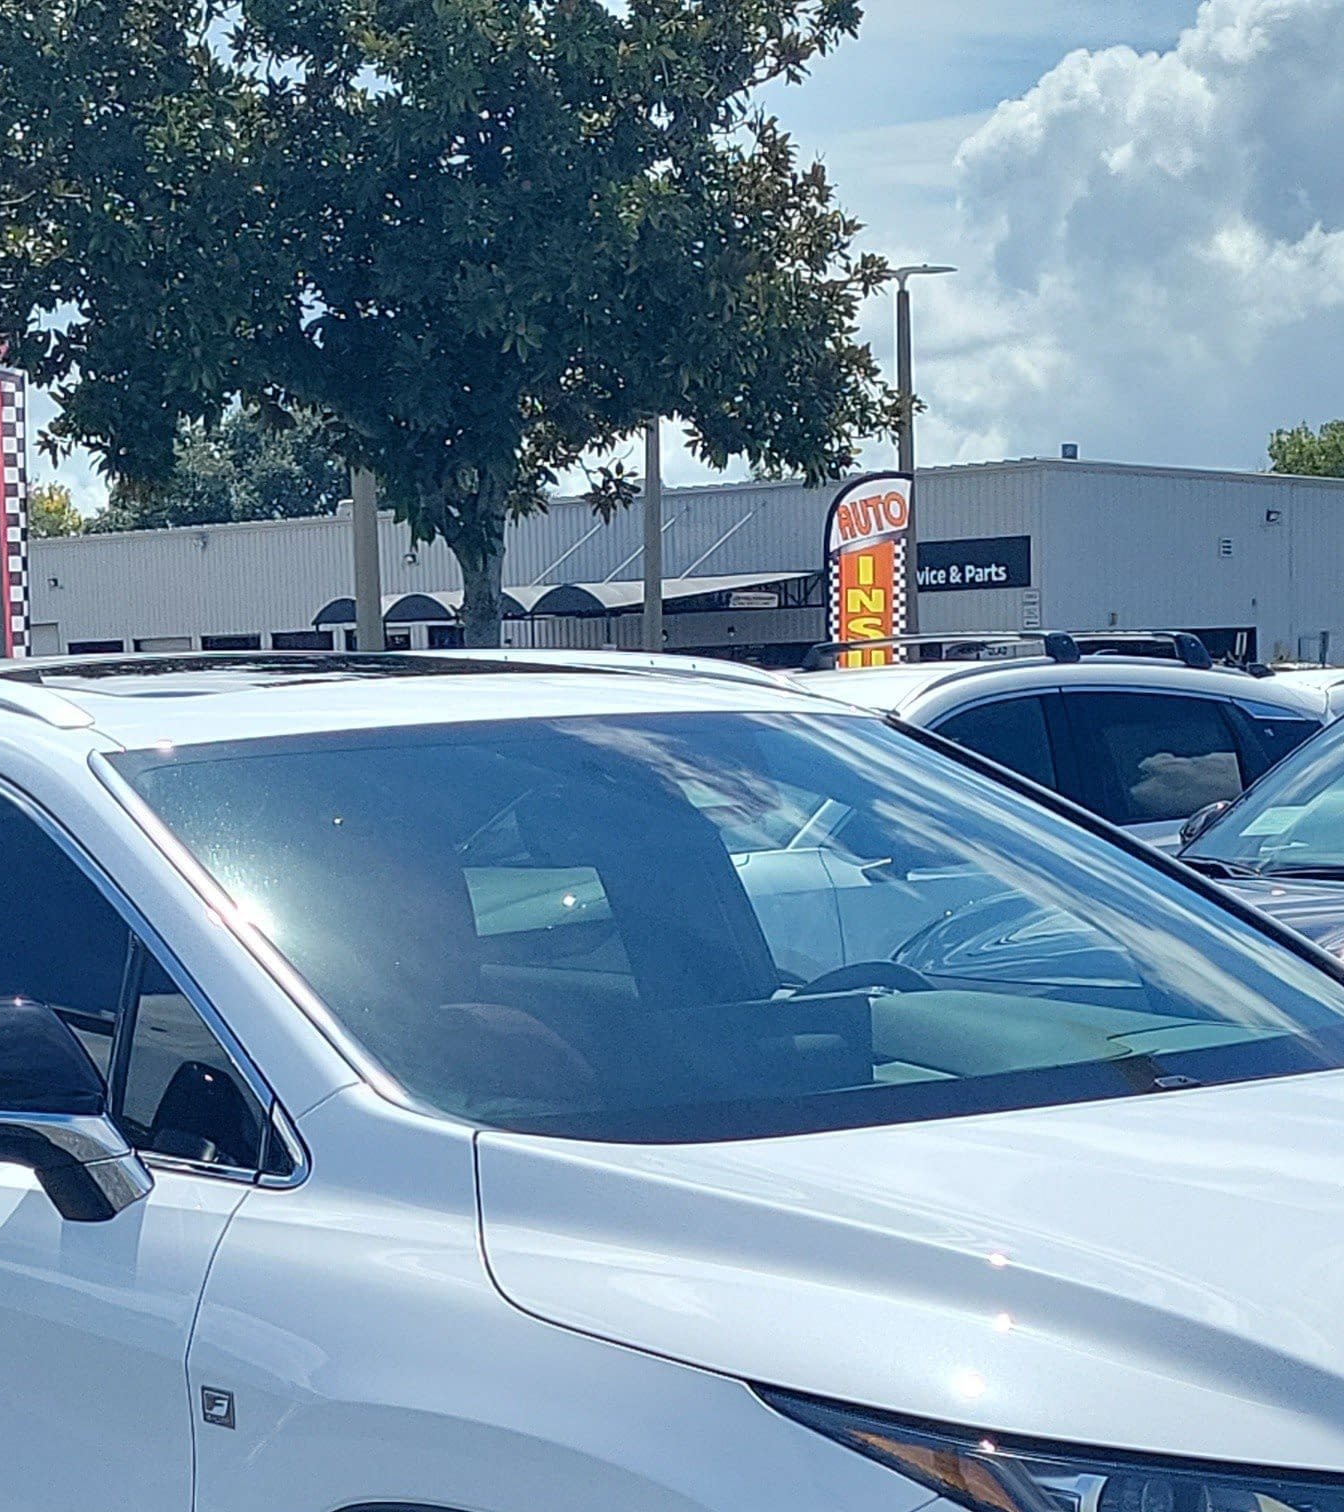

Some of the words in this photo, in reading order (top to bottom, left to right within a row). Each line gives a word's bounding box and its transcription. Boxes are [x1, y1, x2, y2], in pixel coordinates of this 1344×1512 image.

[838, 491, 907, 540] AUTO
[949, 565, 962, 584] &
[965, 563, 1007, 583] Parts
